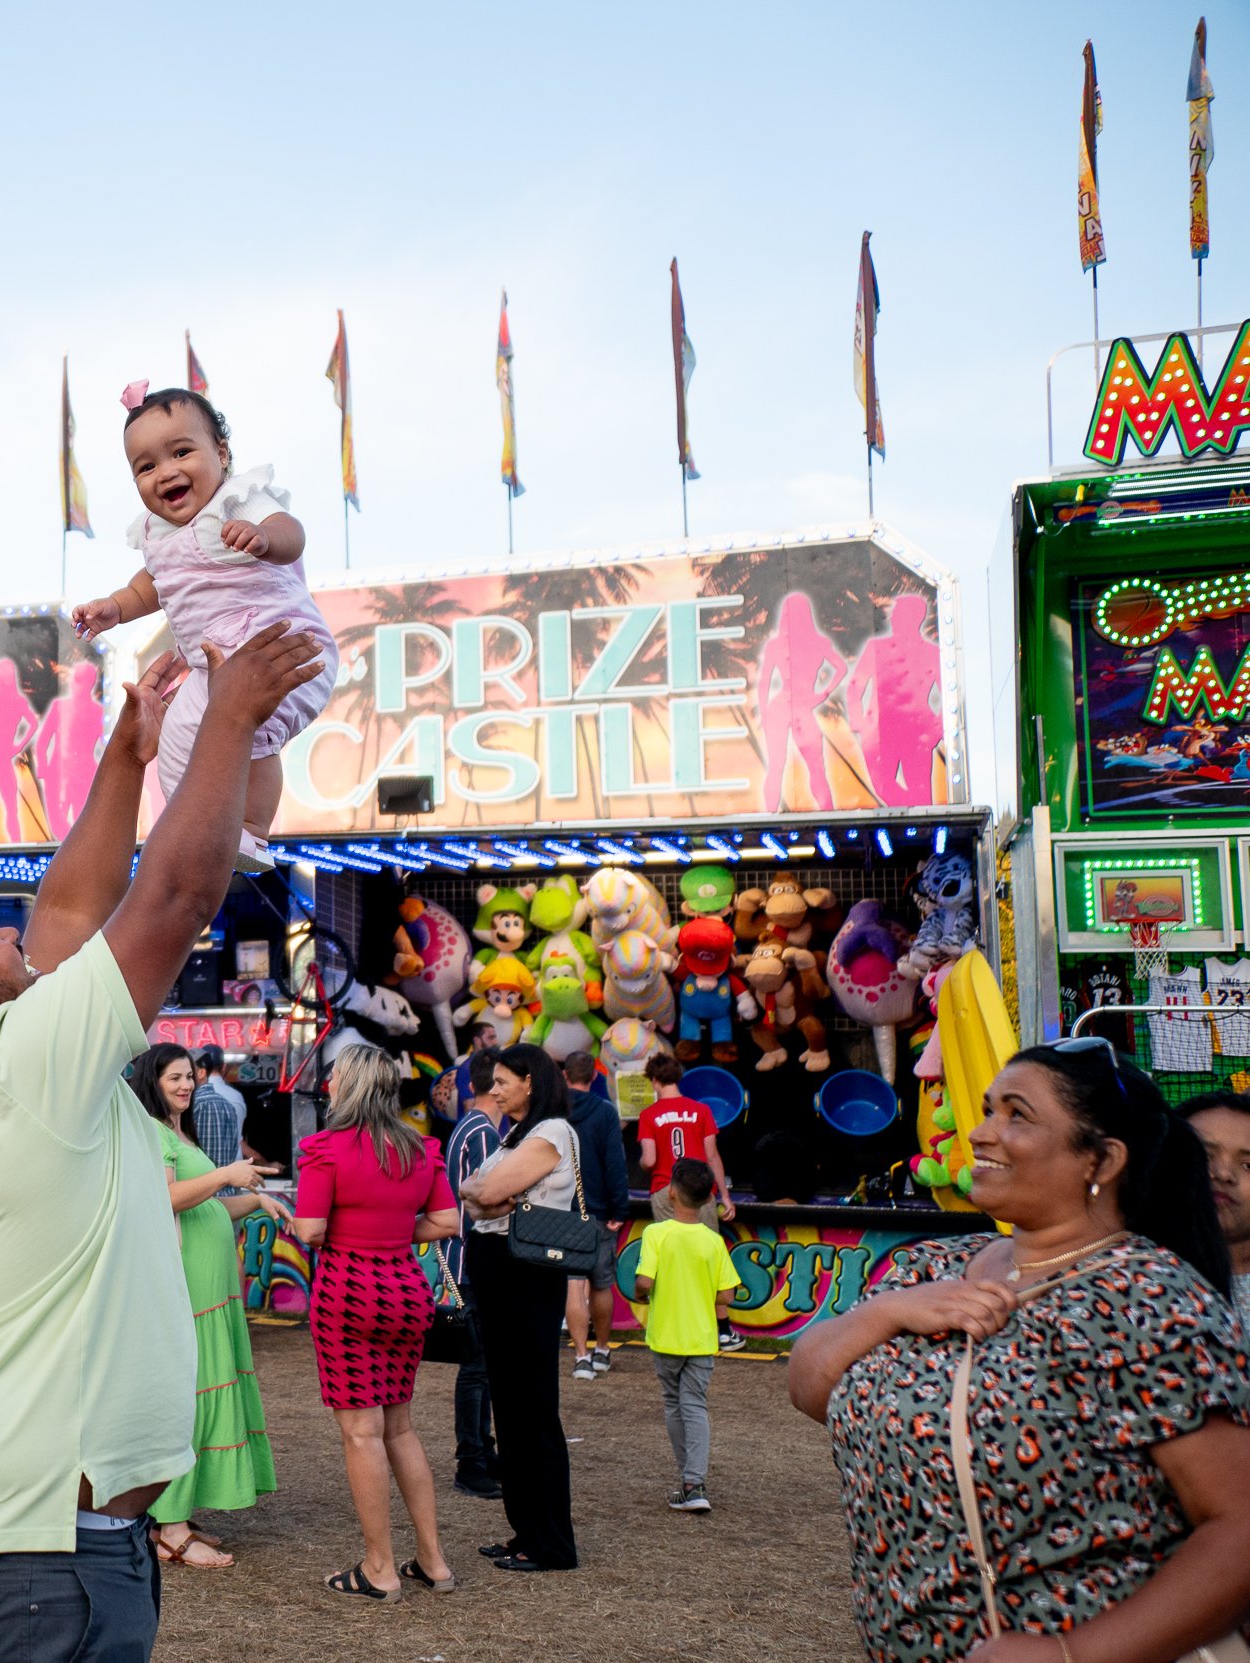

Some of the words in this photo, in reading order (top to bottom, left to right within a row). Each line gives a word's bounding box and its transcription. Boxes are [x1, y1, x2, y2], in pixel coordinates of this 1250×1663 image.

[374, 594, 746, 713] PRIZE
[283, 692, 752, 811] CASTLE
[157, 1017, 244, 1049] STAR
[671, 1127, 686, 1159] 9
